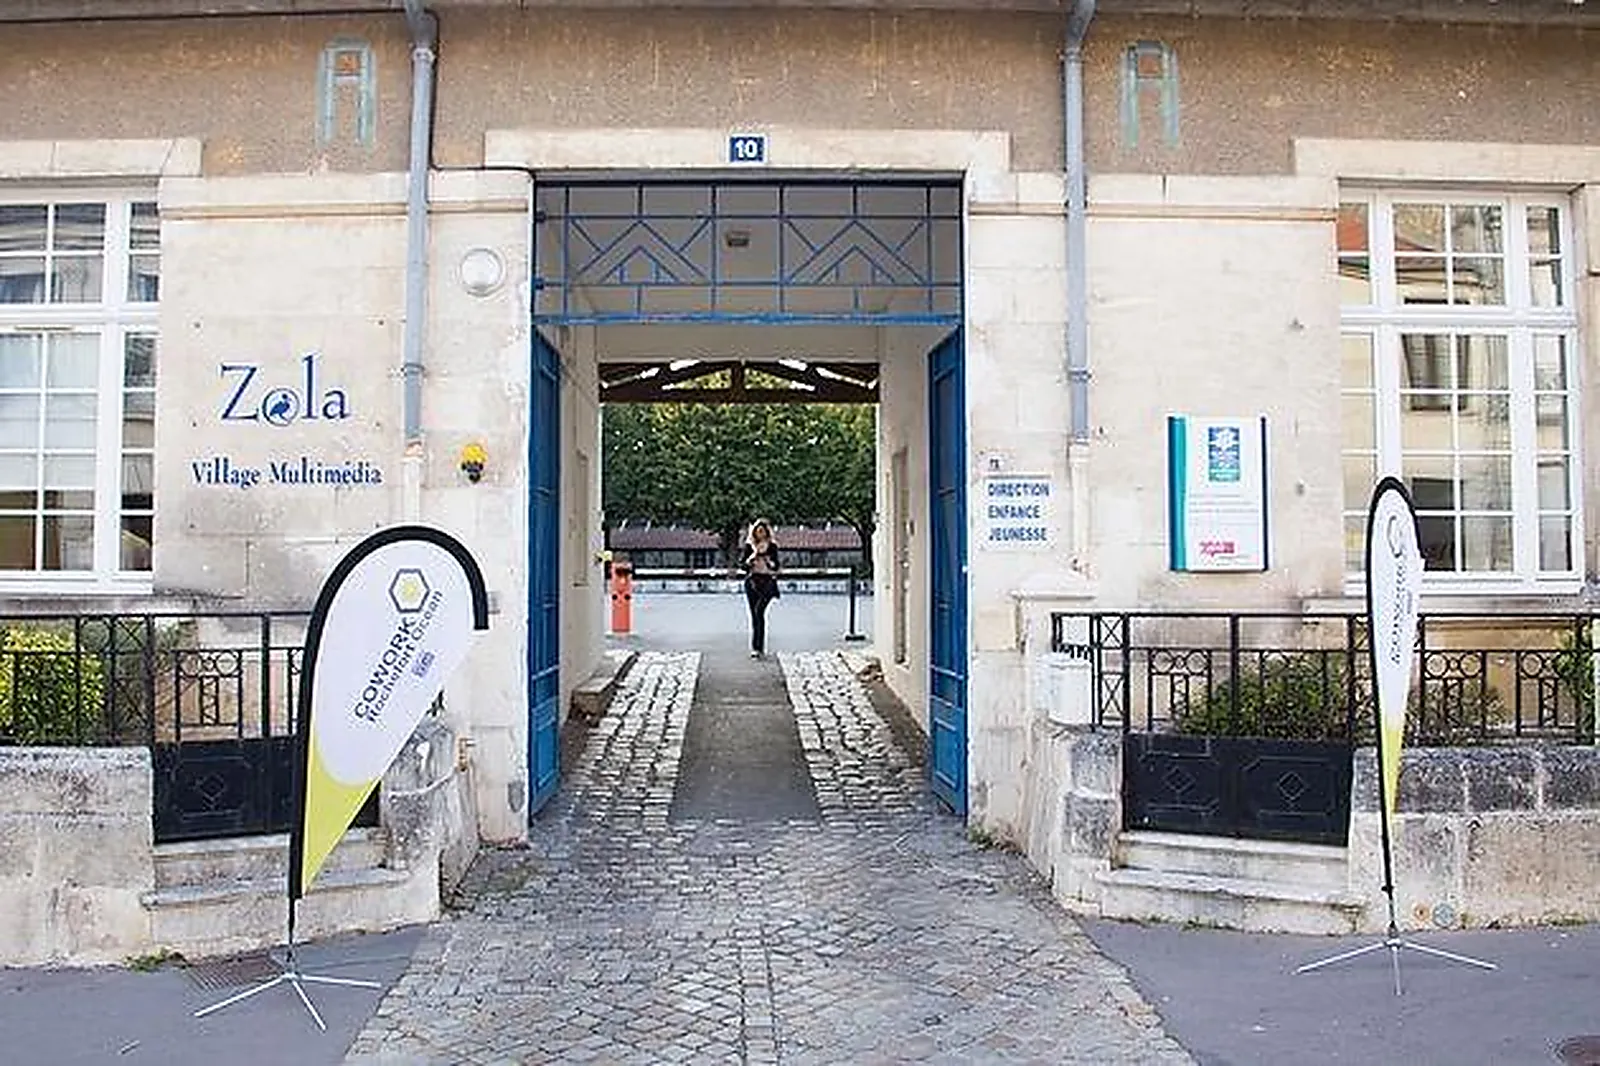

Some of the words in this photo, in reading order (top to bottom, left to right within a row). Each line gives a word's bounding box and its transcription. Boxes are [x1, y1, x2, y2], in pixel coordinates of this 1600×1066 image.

[735, 139, 758, 158] 10
[220, 354, 351, 427] Zola
[192, 456, 261, 490] Village
[269, 456, 382, 484] Multimédia
[988, 482, 1050, 497] DIRECTION
[988, 504, 1041, 519] ENFANCE
[988, 526, 1047, 542] JEUNESSE
[354, 617, 417, 719] COWORK
